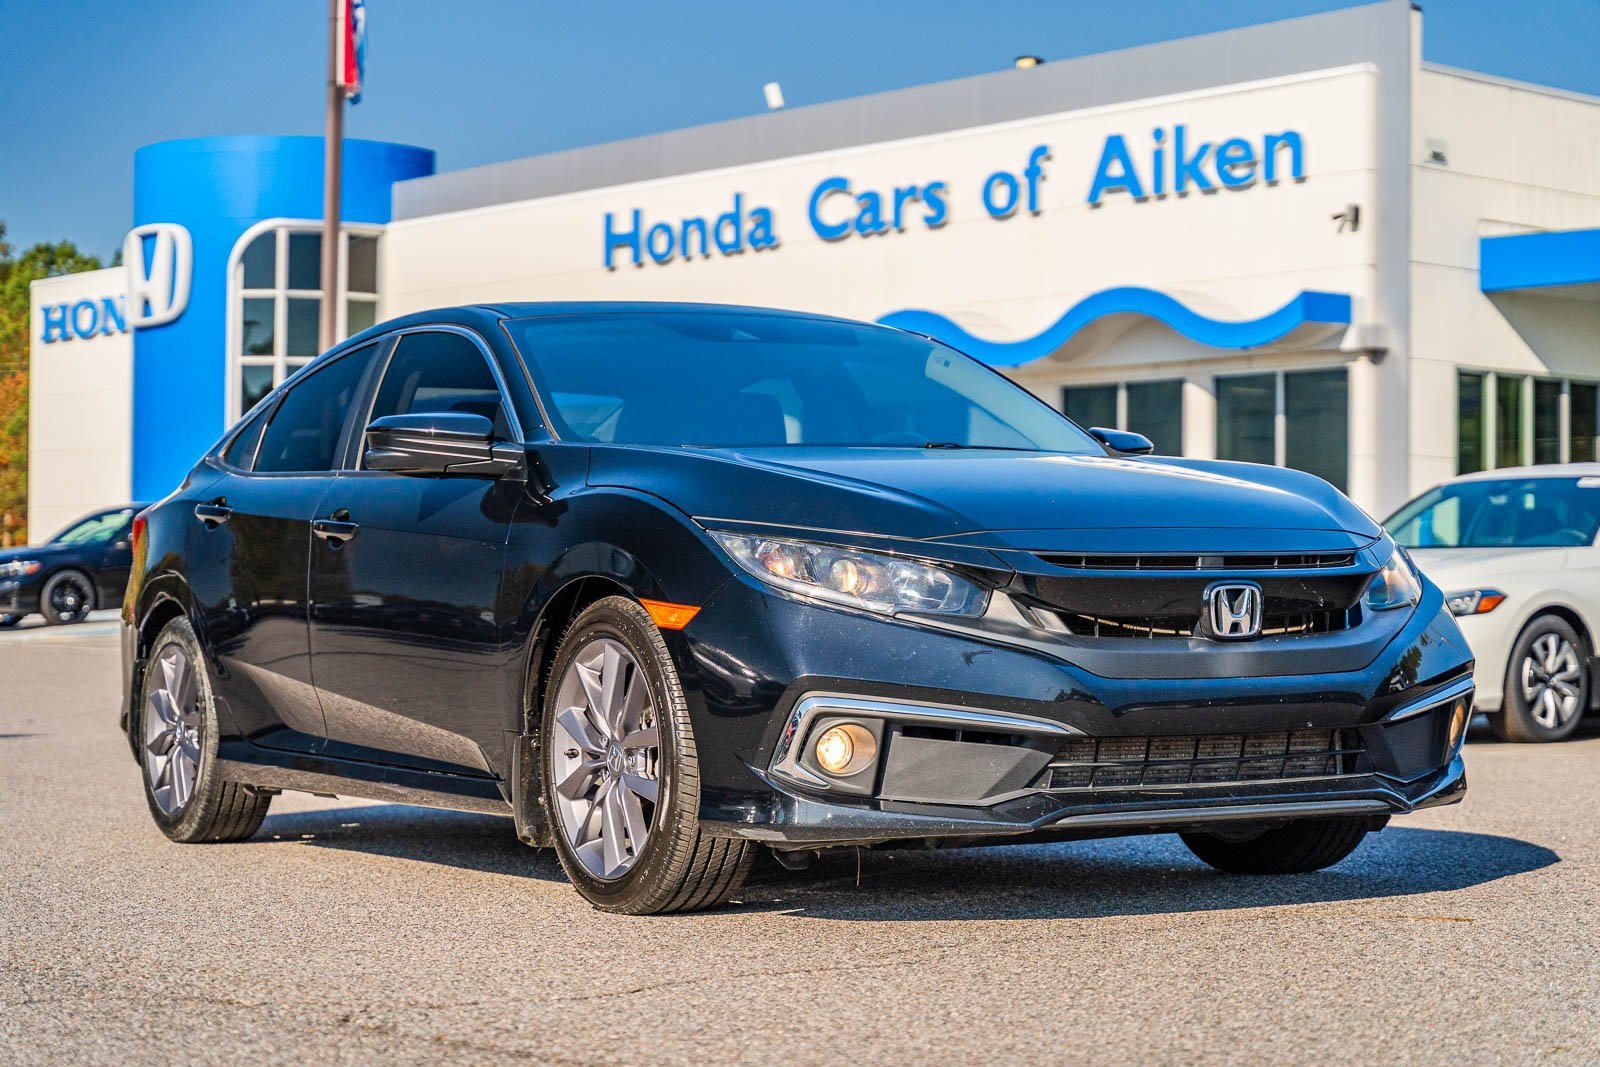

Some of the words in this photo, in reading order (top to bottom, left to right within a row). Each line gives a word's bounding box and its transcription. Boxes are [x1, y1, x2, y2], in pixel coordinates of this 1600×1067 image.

[604, 191, 779, 270] Honda
[807, 176, 948, 241] Cars
[981, 144, 1051, 219] of
[1086, 124, 1304, 205] Aiken
